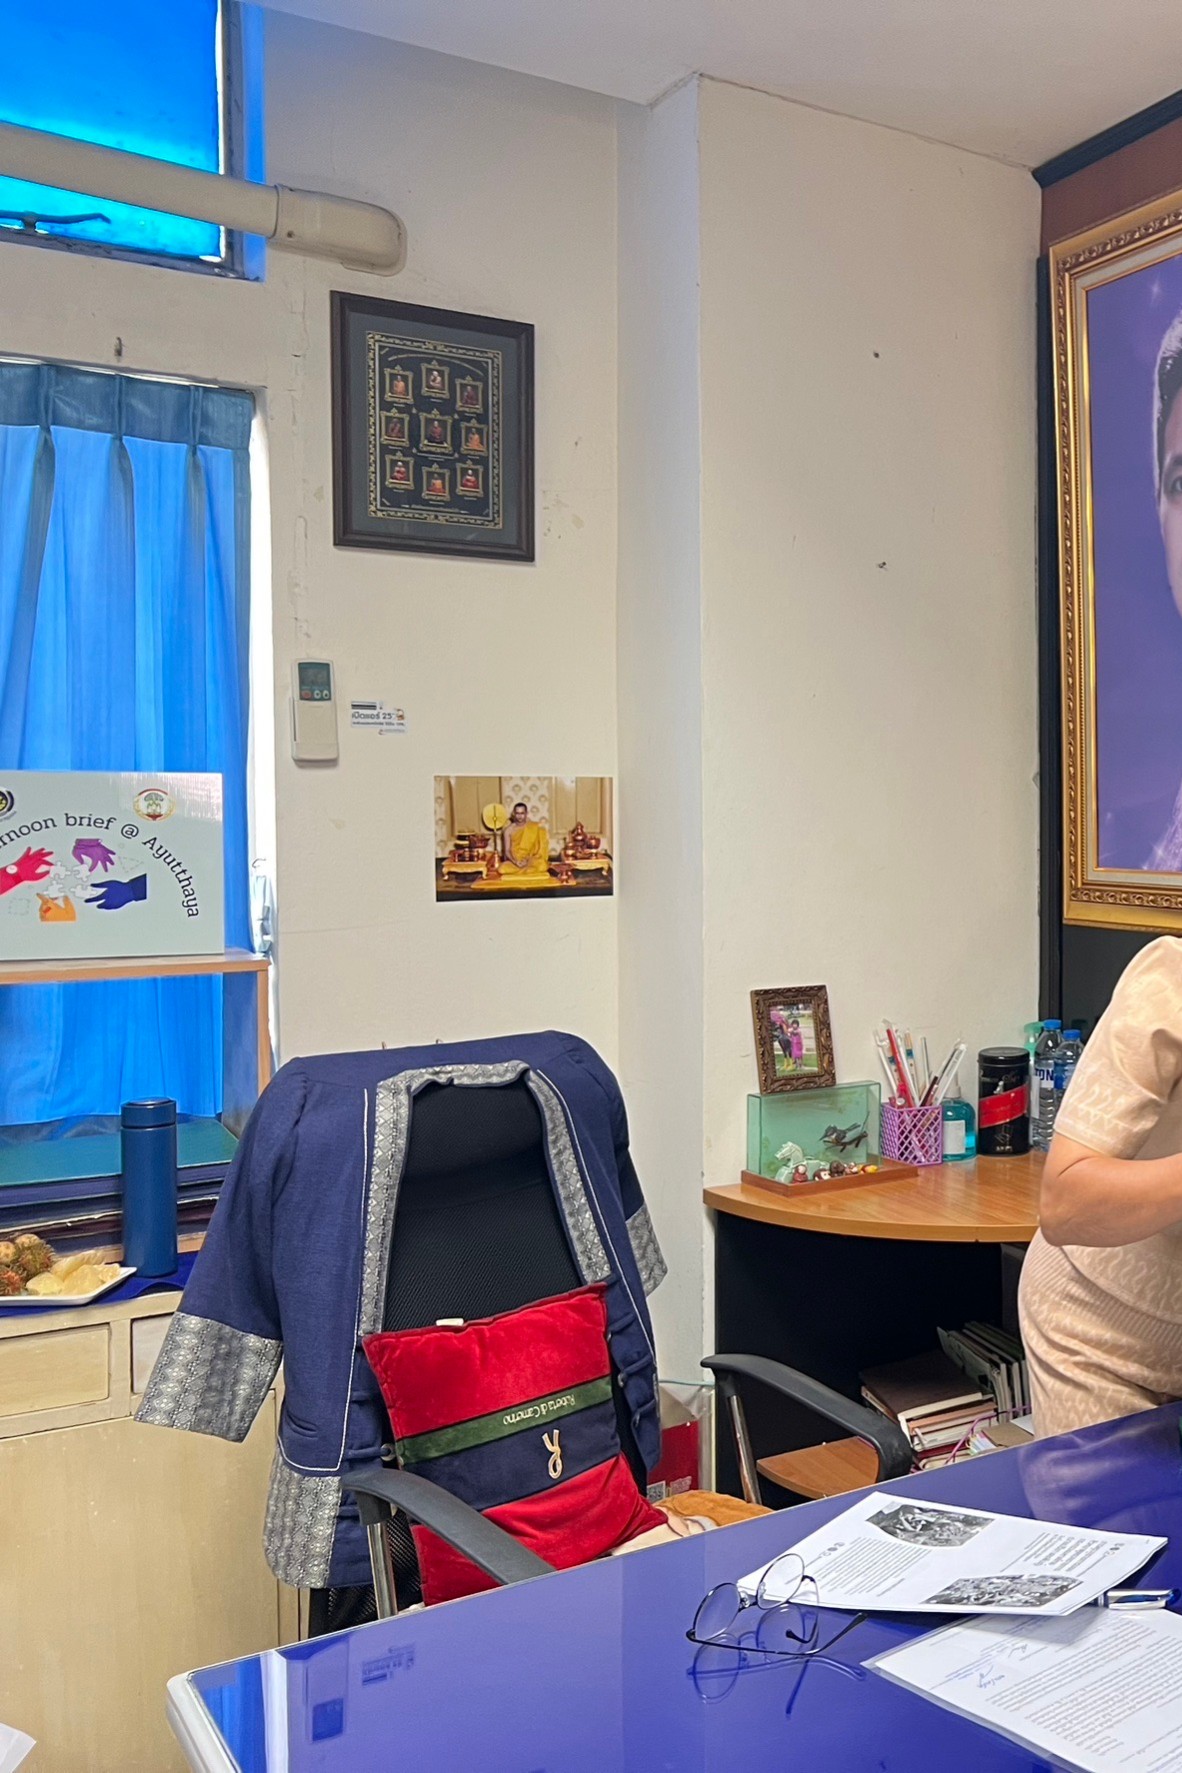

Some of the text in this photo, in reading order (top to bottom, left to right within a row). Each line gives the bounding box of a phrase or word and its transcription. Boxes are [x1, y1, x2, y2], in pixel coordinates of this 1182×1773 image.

[64, 812, 117, 831] brief
[121, 823, 139, 839] @
[141, 836, 199, 918] Ayutthaya
